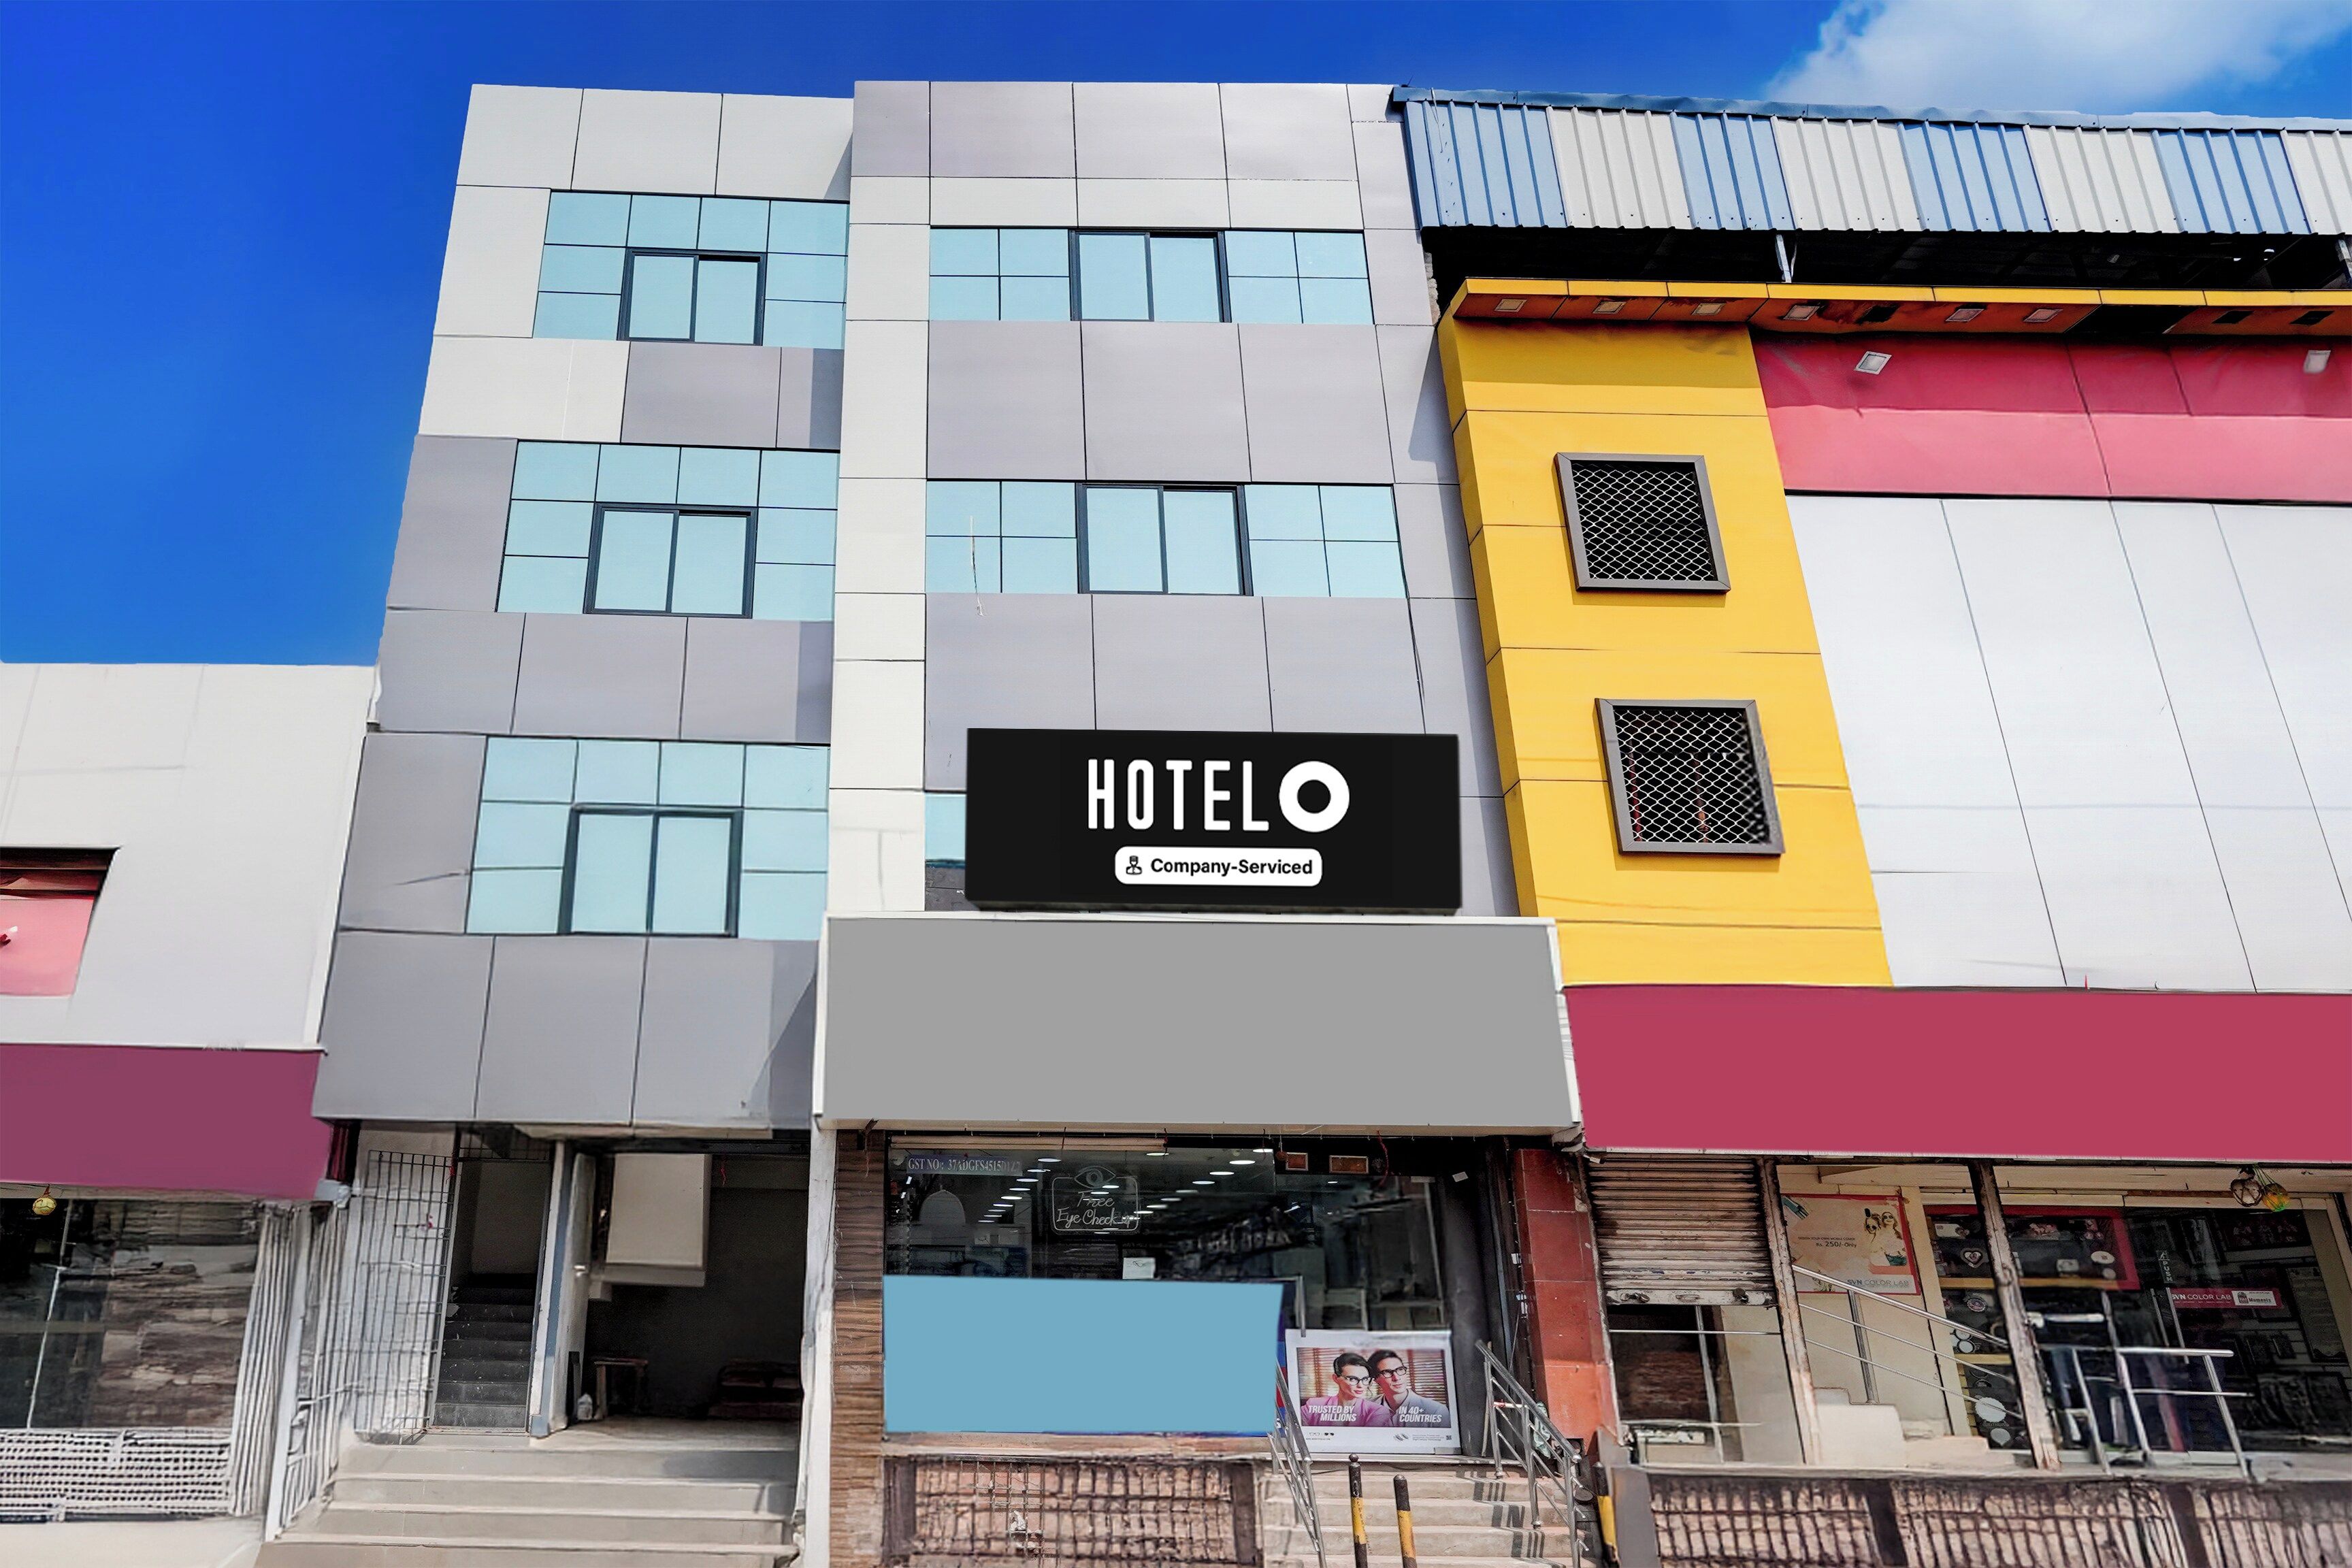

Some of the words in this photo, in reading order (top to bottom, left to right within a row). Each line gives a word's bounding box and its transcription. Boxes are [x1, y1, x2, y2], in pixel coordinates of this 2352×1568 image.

[1150, 858, 1313, 877] Company-Serviced
[908, 1158, 925, 1170] GST
[1077, 1190, 1115, 1208] Free
[1056, 1207, 1082, 1228] Eye
[1308, 1405, 1343, 1414] TRUSTED
[1343, 1405, 1355, 1414] BY
[1399, 1406, 1407, 1415] IN
[1408, 1406, 1424, 1415] 40+
[1320, 1413, 1358, 1422] MILLIONS
[1399, 1414, 1442, 1423] COUNTRIES
